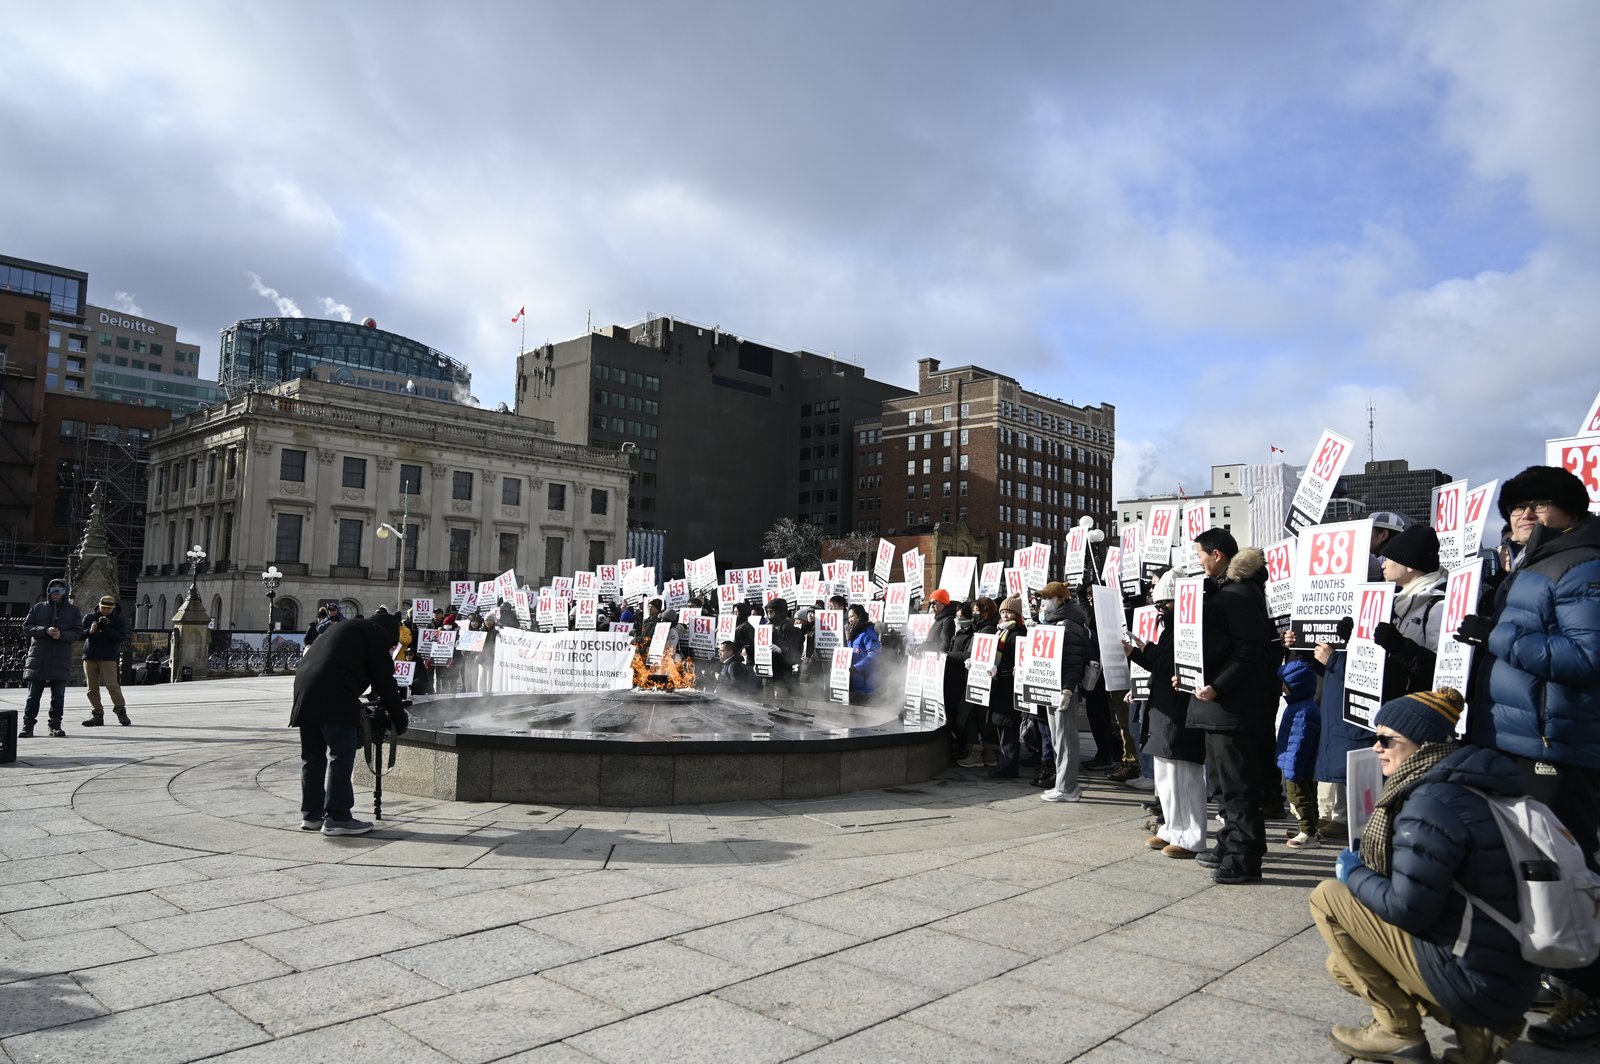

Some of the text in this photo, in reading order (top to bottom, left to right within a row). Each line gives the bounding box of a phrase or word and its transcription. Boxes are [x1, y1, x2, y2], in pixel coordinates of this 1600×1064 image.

[99, 312, 155, 334] Deloitte
[1314, 439, 1342, 479] 38
[1567, 445, 1600, 502] 33
[1438, 490, 1456, 531] 30
[1153, 510, 1171, 536] 37
[1189, 508, 1204, 541] 39
[1071, 529, 1084, 552] 70
[1124, 528, 1135, 553] 28
[1313, 532, 1350, 575] 38
[1450, 548, 1458, 558] FOR
[768, 561, 782, 575] 27
[906, 552, 916, 572] 29
[1270, 547, 1289, 581] 32
[578, 574, 590, 587] 15
[602, 567, 614, 580] 53
[730, 572, 743, 583] 39
[748, 570, 761, 584] 34
[781, 572, 792, 588] 33
[984, 565, 998, 582] 28
[457, 583, 470, 594] 54
[670, 582, 684, 596] 55
[851, 575, 864, 592] 65
[1009, 571, 1022, 594] 31
[1273, 582, 1290, 593] MONTHS
[1311, 579, 1345, 589] MONTHS
[722, 586, 735, 601] 34
[891, 586, 905, 604] 72
[1270, 594, 1286, 604] WAITING
[1302, 592, 1354, 602] WAITING FOR
[417, 600, 429, 611] 30
[581, 600, 593, 614] 34
[1180, 585, 1196, 624] 37
[1279, 602, 1292, 612] RESPO
[1296, 605, 1353, 615] IRCC RESPONS
[1448, 574, 1468, 632] 31
[869, 604, 880, 621] 62
[1360, 591, 1382, 639] 40
[694, 618, 710, 634] 81
[721, 617, 732, 633] 33
[820, 613, 837, 630] 40
[1140, 612, 1158, 643] 37
[1302, 624, 1338, 632] NO TIMELI
[758, 628, 768, 645] 34
[1034, 630, 1054, 657] 37
[1305, 634, 1314, 643] NO
[580, 640, 630, 651] DECISION
[976, 638, 992, 662] 14
[1357, 645, 1374, 658] MONTHS
[555, 652, 592, 663] BY IRCC
[396, 663, 410, 675] 36
[554, 668, 595, 677] PROCEDURAL
[597, 670, 626, 678] FAIRNESS
[1351, 659, 1378, 674] WAITING FOR
[1035, 677, 1058, 686] RESPONSE
[1356, 674, 1378, 690] RESPONSE
